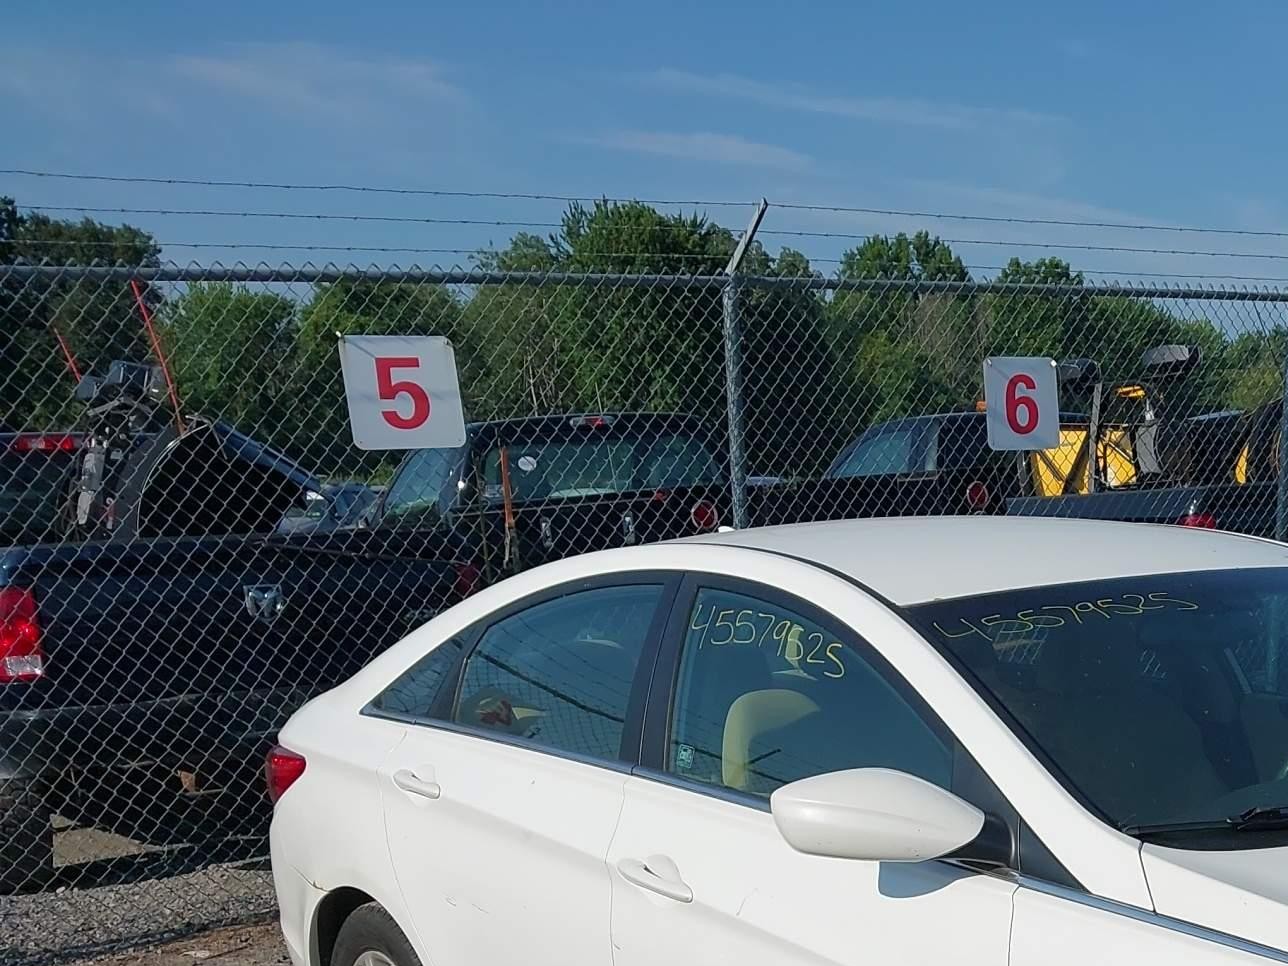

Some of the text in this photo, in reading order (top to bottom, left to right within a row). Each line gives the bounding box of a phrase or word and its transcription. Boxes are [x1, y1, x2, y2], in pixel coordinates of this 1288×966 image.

[375, 357, 430, 429] 5
[1006, 374, 1038, 434] 6
[690, 603, 846, 679] 45579525
[933, 592, 1199, 641] 45579525
